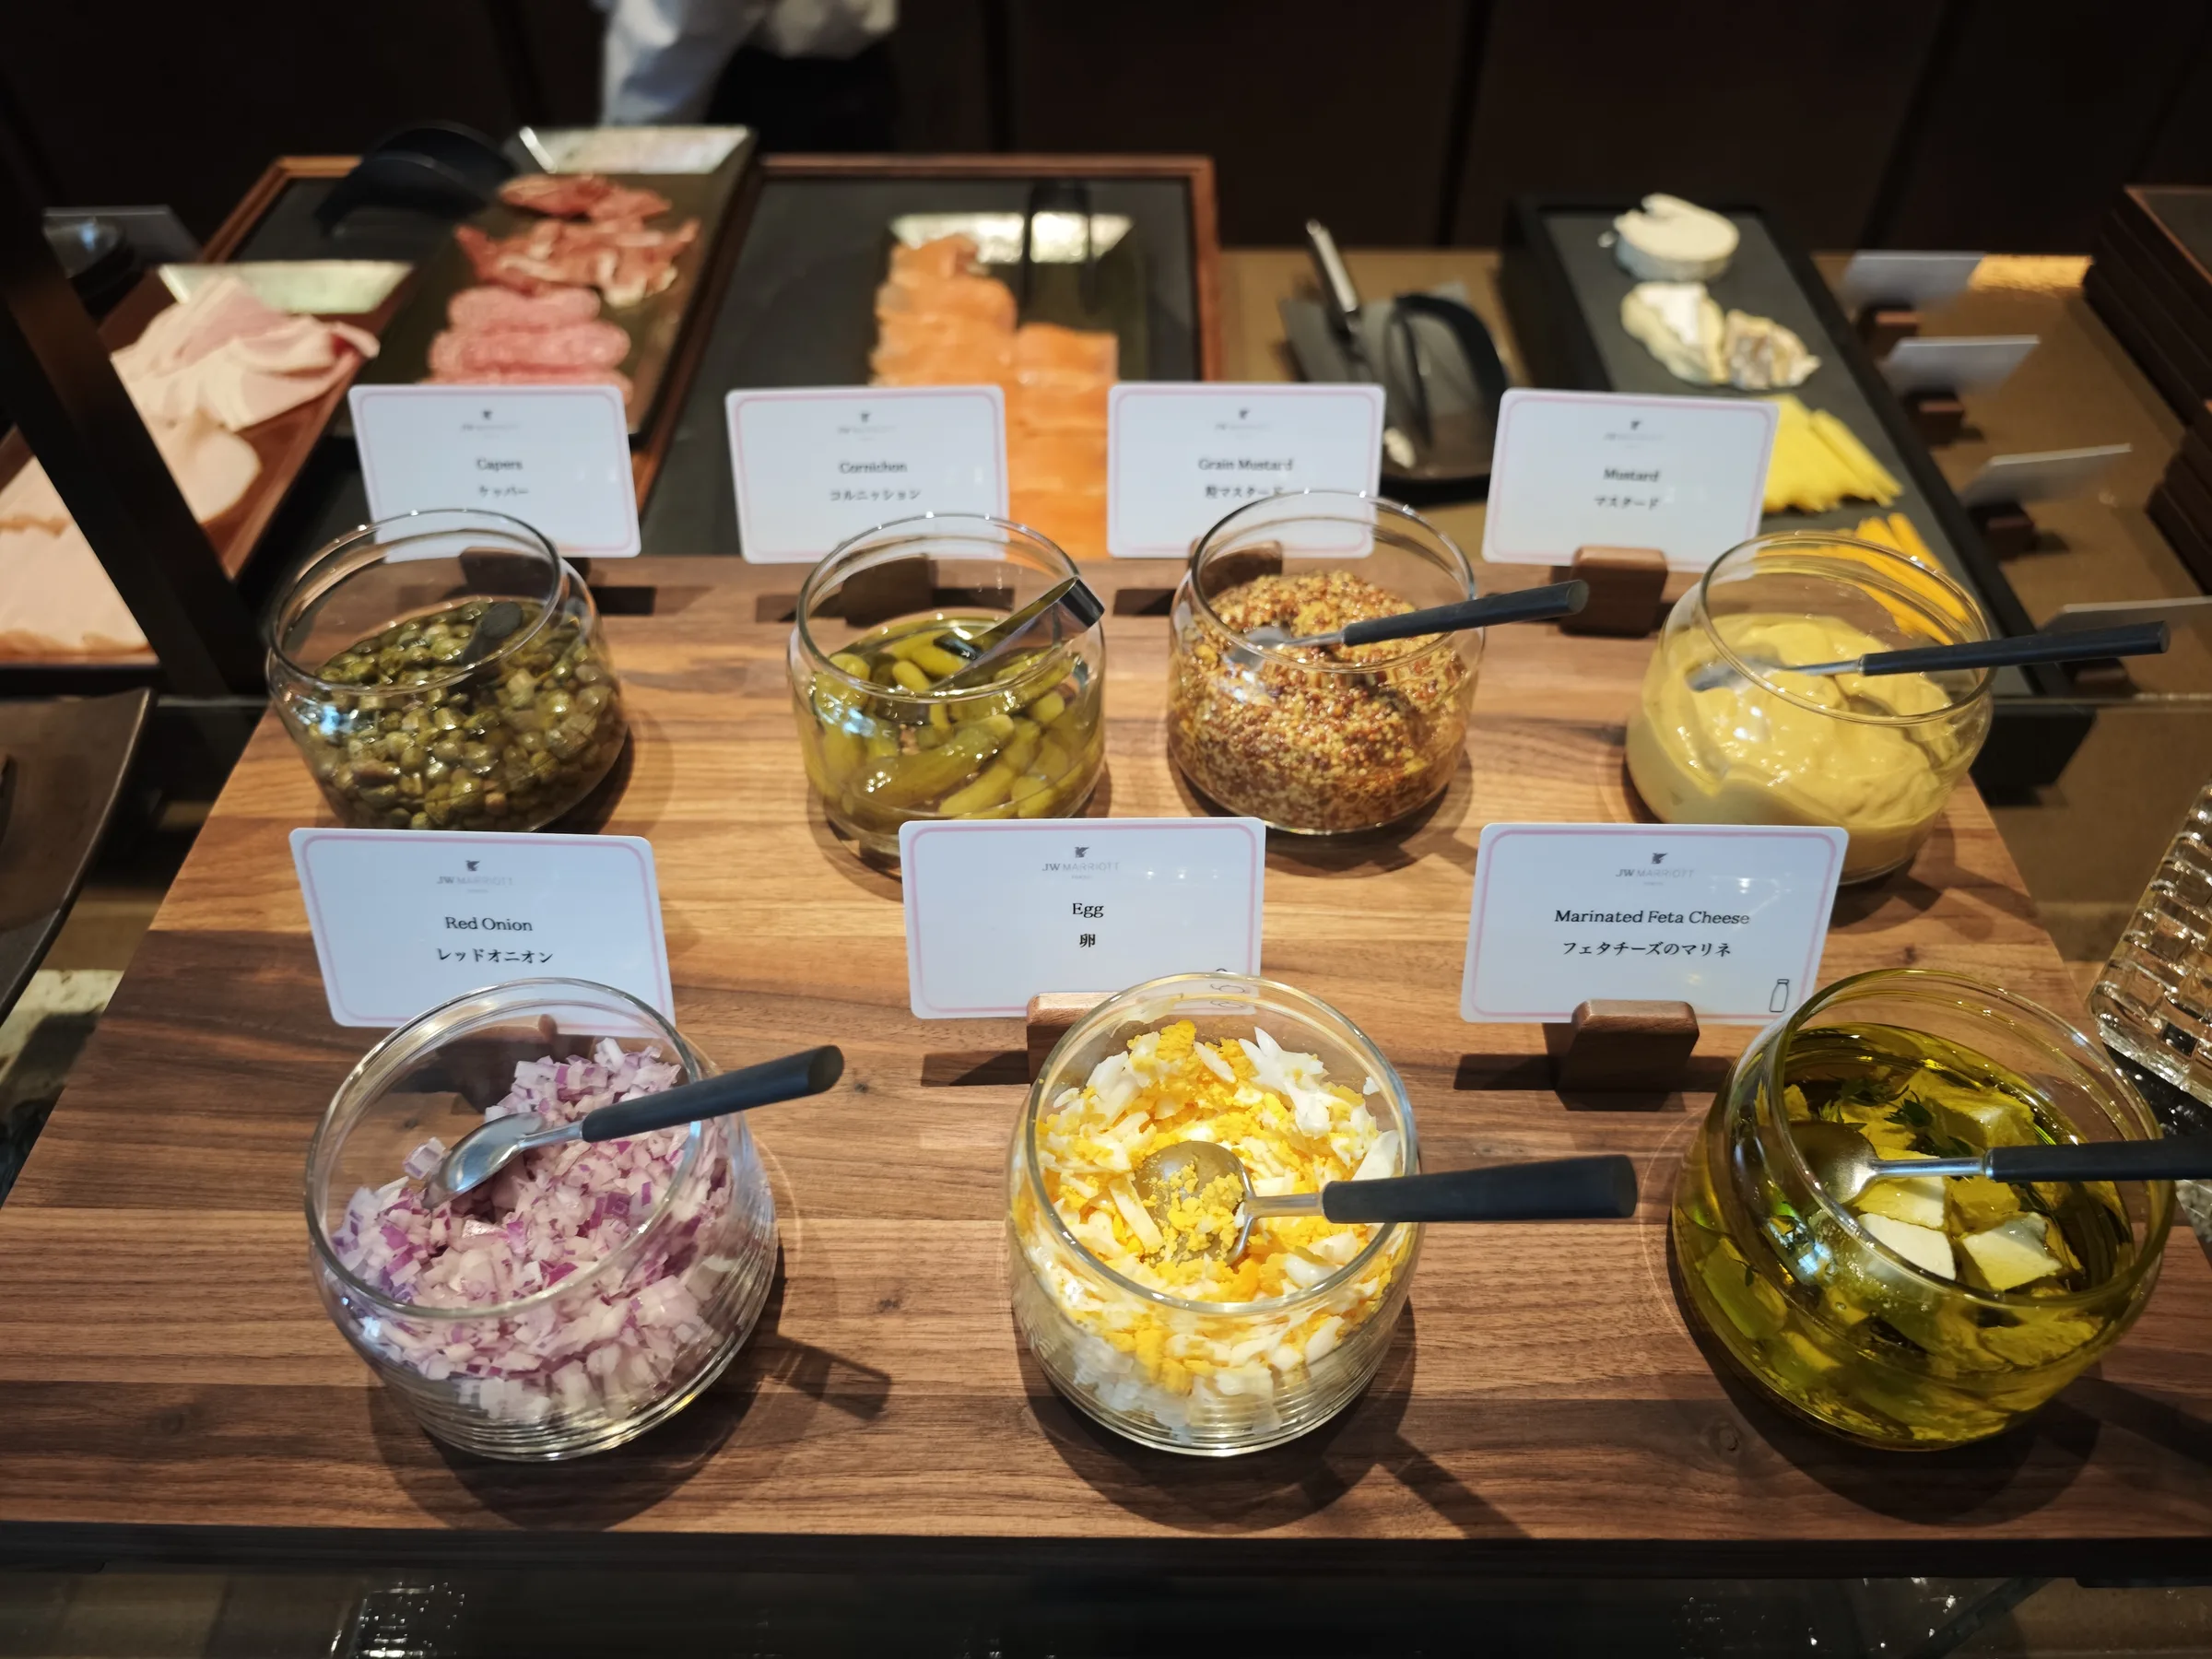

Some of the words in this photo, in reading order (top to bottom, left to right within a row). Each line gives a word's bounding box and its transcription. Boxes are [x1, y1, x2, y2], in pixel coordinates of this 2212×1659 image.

[477, 459, 524, 472] Capers
[840, 461, 908, 474] Cornichon
[1198, 459, 1234, 471] Grain
[1238, 459, 1294, 471] Mustard
[1604, 468, 1661, 482] Mustard
[1042, 863, 1060, 872] JW
[1616, 868, 1635, 877] JW
[437, 876, 454, 885] JW
[1072, 902, 1104, 918] Egg
[1555, 910, 1643, 924] Marinated
[1648, 911, 1685, 924] Feta
[1688, 911, 1750, 924] Cheese
[445, 916, 478, 930] Red
[482, 917, 534, 931] Onion
[1079, 933, 1096, 947] 卵
[437, 947, 553, 964] レッドオニオン
[1563, 941, 1731, 958] フェタチーズのマリネ
